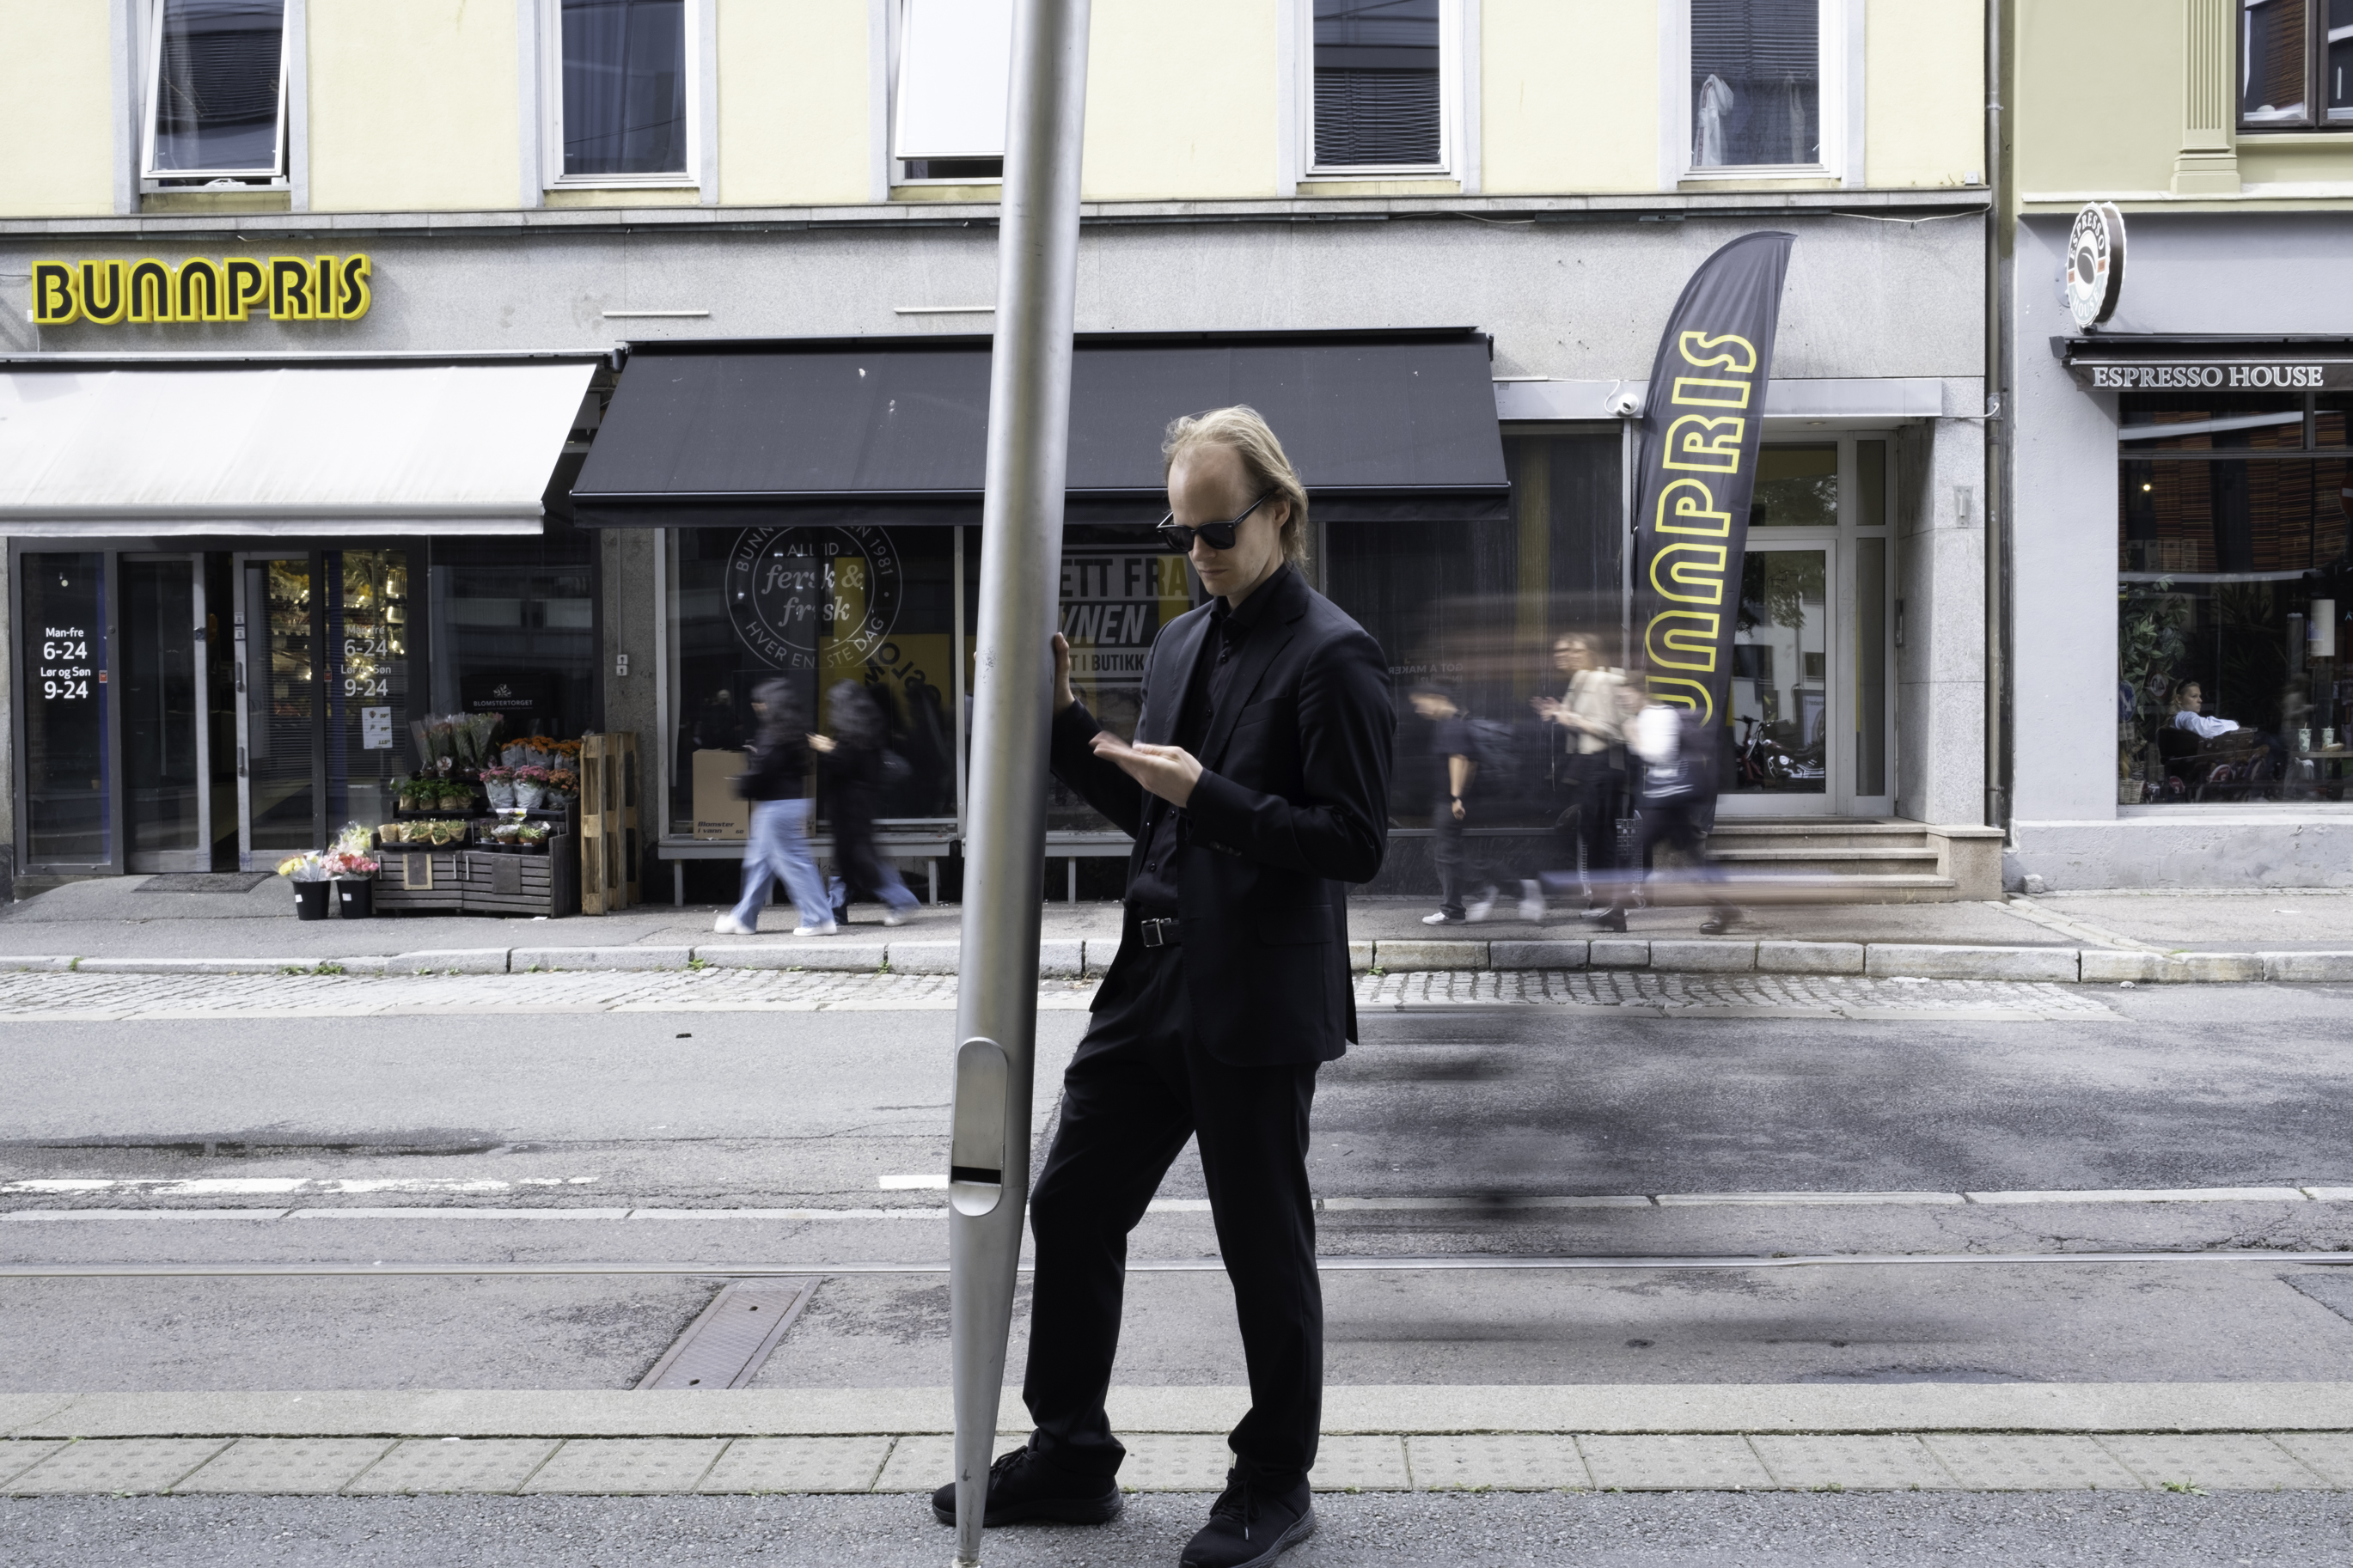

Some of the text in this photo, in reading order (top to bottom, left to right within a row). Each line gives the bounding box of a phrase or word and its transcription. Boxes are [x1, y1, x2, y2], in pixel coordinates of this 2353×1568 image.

[2069, 211, 2105, 260] ESPRESSO
[32, 253, 371, 324] BUNNPRIS
[2072, 287, 2099, 318] HOUSE
[2092, 366, 2324, 387] ESPRESSO HOUSE
[1645, 330, 1757, 729] UNNPRIS
[786, 543, 840, 557] ALLID
[870, 538, 894, 575] 1981
[840, 564, 865, 588] &
[1059, 558, 1189, 597] ETT FRA
[46, 627, 84, 638] Man-fre
[1058, 605, 1147, 644] VNEN
[43, 641, 88, 660] 6-24
[344, 639, 388, 657] 6-24
[745, 617, 884, 668] HVER ENSTE DAG
[40, 666, 91, 680] Lør og Søn
[340, 664, 356, 674] Lør
[373, 664, 392, 674] Søn
[1091, 654, 1145, 671] BUTIKK
[44, 680, 89, 699] 9-24
[344, 679, 388, 697] 9-24
